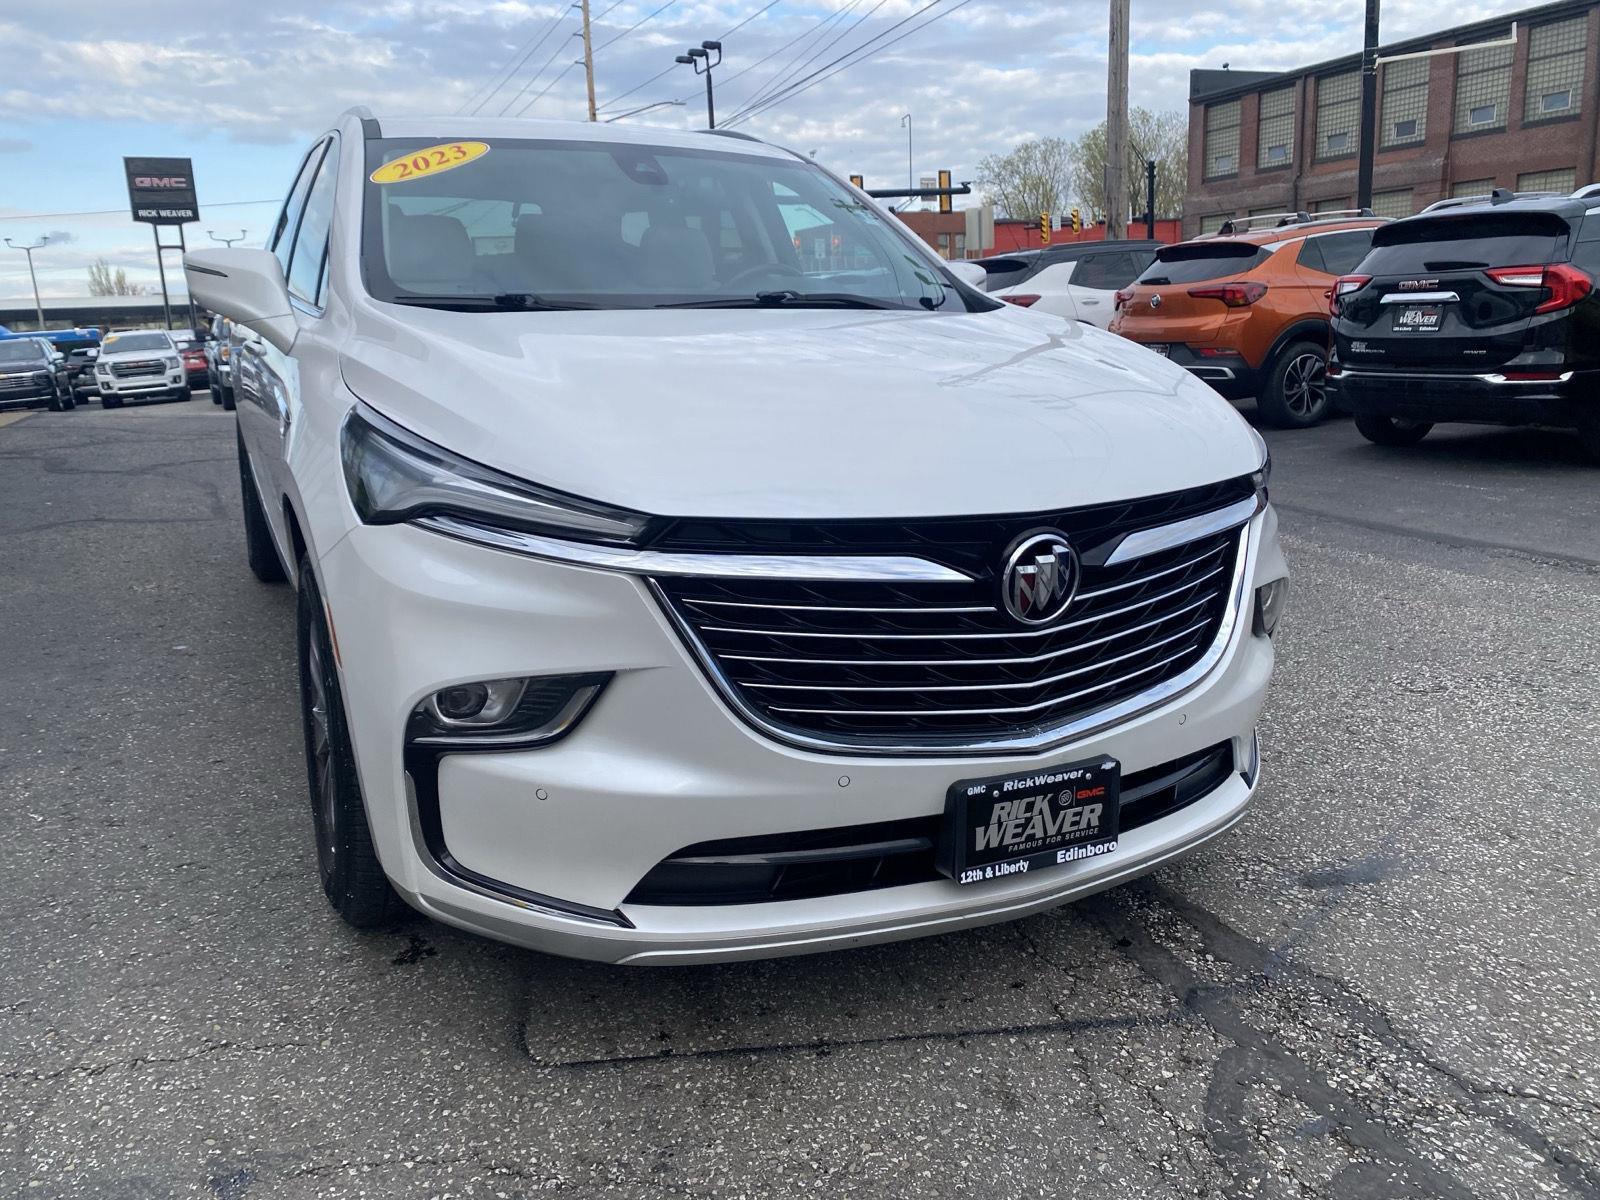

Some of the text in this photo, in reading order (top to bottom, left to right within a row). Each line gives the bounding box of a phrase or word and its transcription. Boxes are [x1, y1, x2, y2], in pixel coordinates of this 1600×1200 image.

[393, 145, 467, 178] 2023
[134, 177, 187, 187] GMC
[138, 209, 193, 217] RICK WEAVER
[1398, 279, 1439, 290] GMC
[1399, 315, 1438, 324] WEAVER
[967, 785, 987, 796] GMC
[1076, 787, 1105, 799] GMC
[990, 793, 1053, 825] RICK
[975, 803, 1103, 851] WEAVER
[1008, 828, 1099, 853] FAMOUS FOR SERVICE
[1056, 841, 1119, 864] Edinboro
[960, 860, 1030, 884] 12th & Liberty
